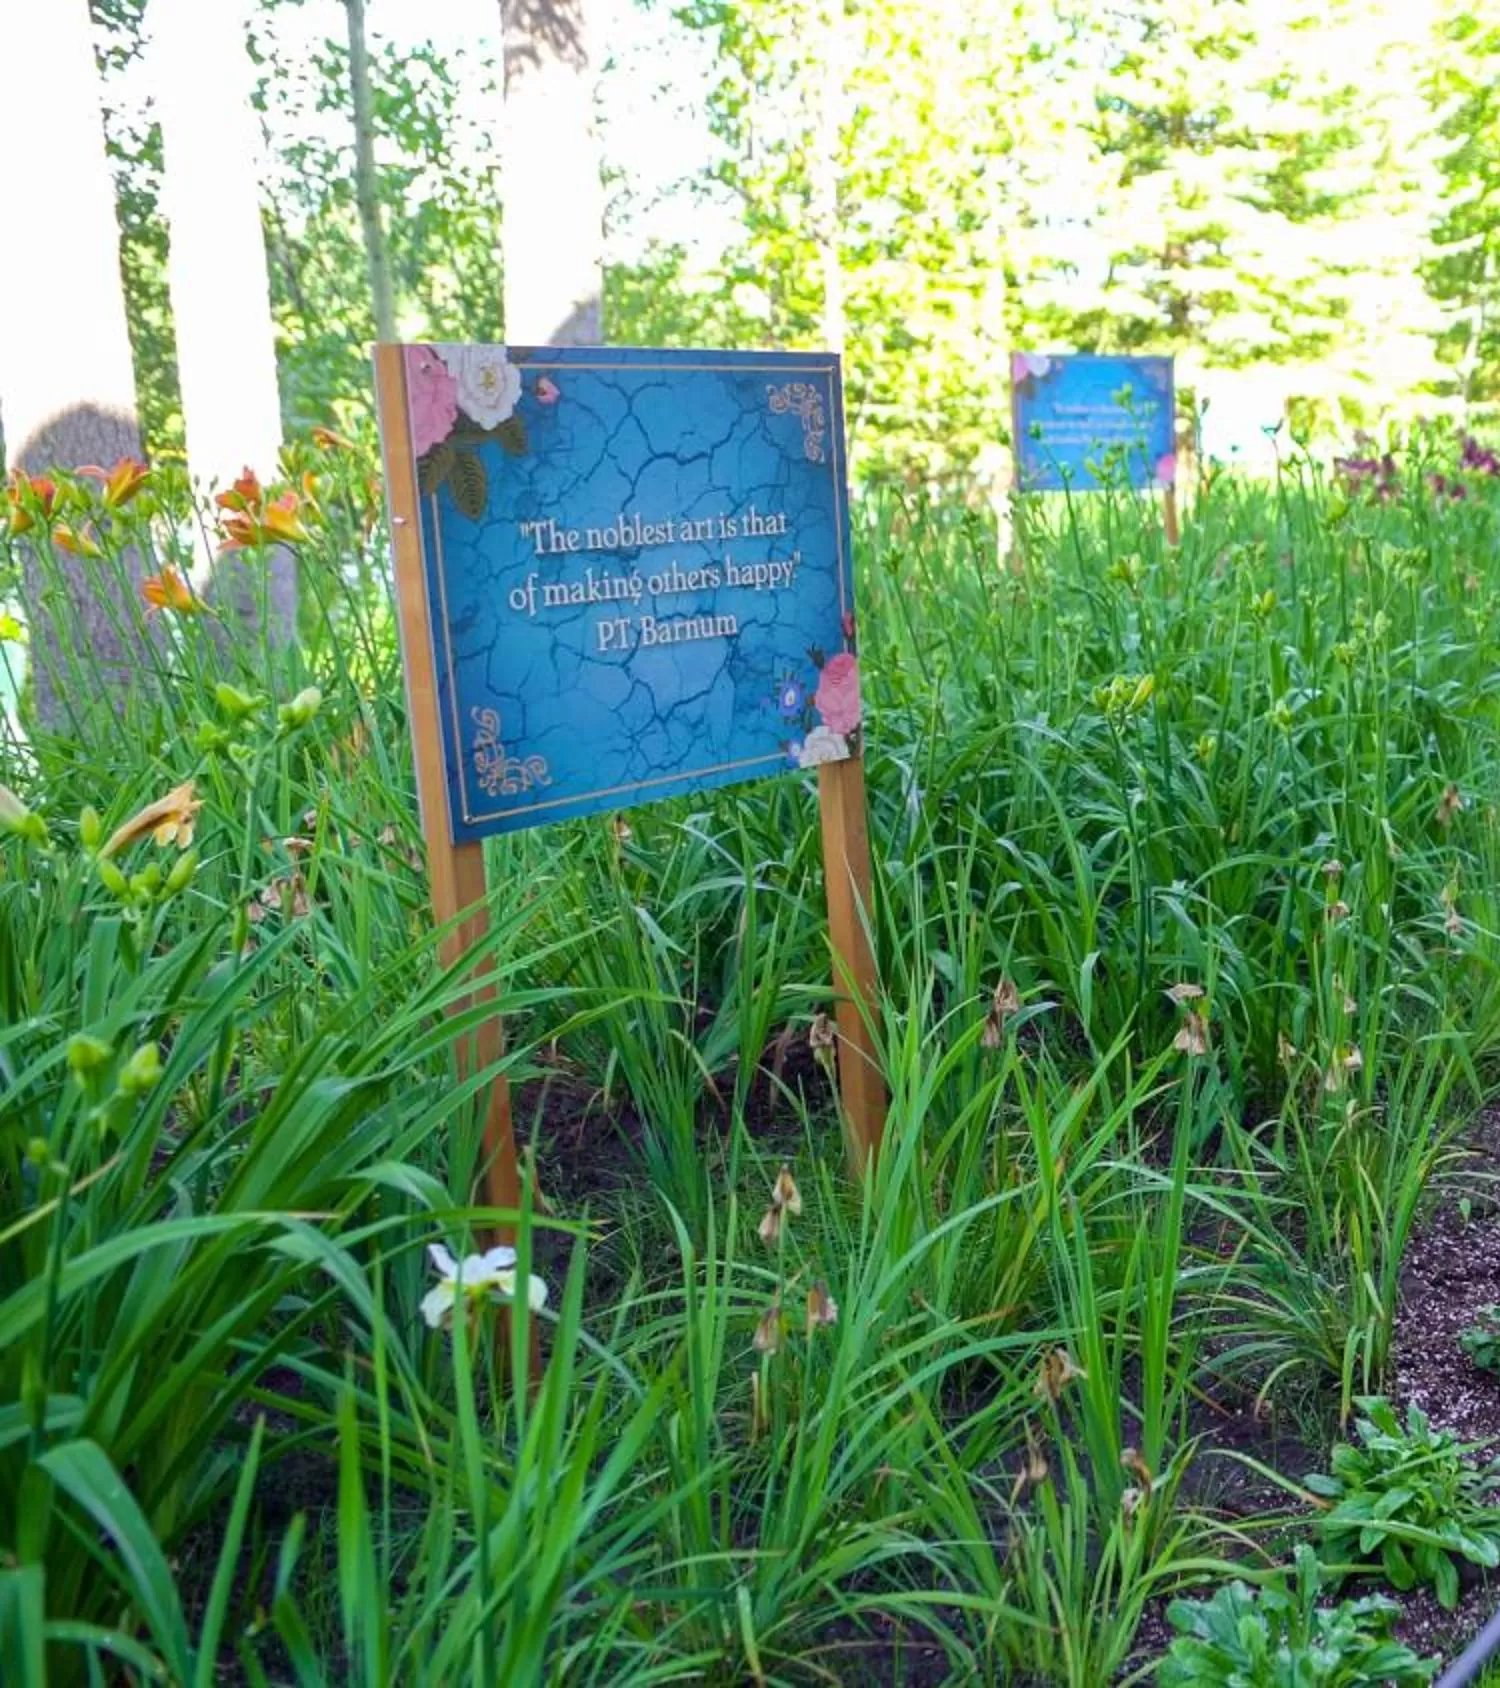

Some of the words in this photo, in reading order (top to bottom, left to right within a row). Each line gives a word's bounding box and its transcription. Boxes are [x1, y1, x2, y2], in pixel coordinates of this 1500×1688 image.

[520, 519, 580, 555] "The
[586, 512, 675, 550] noblest
[678, 517, 714, 541] art
[718, 512, 738, 537] is
[741, 505, 787, 537] that
[509, 574, 538, 616] of
[542, 567, 643, 606] making
[647, 561, 721, 596] others
[597, 617, 636, 651] P.T.
[640, 613, 738, 646] Barnum
